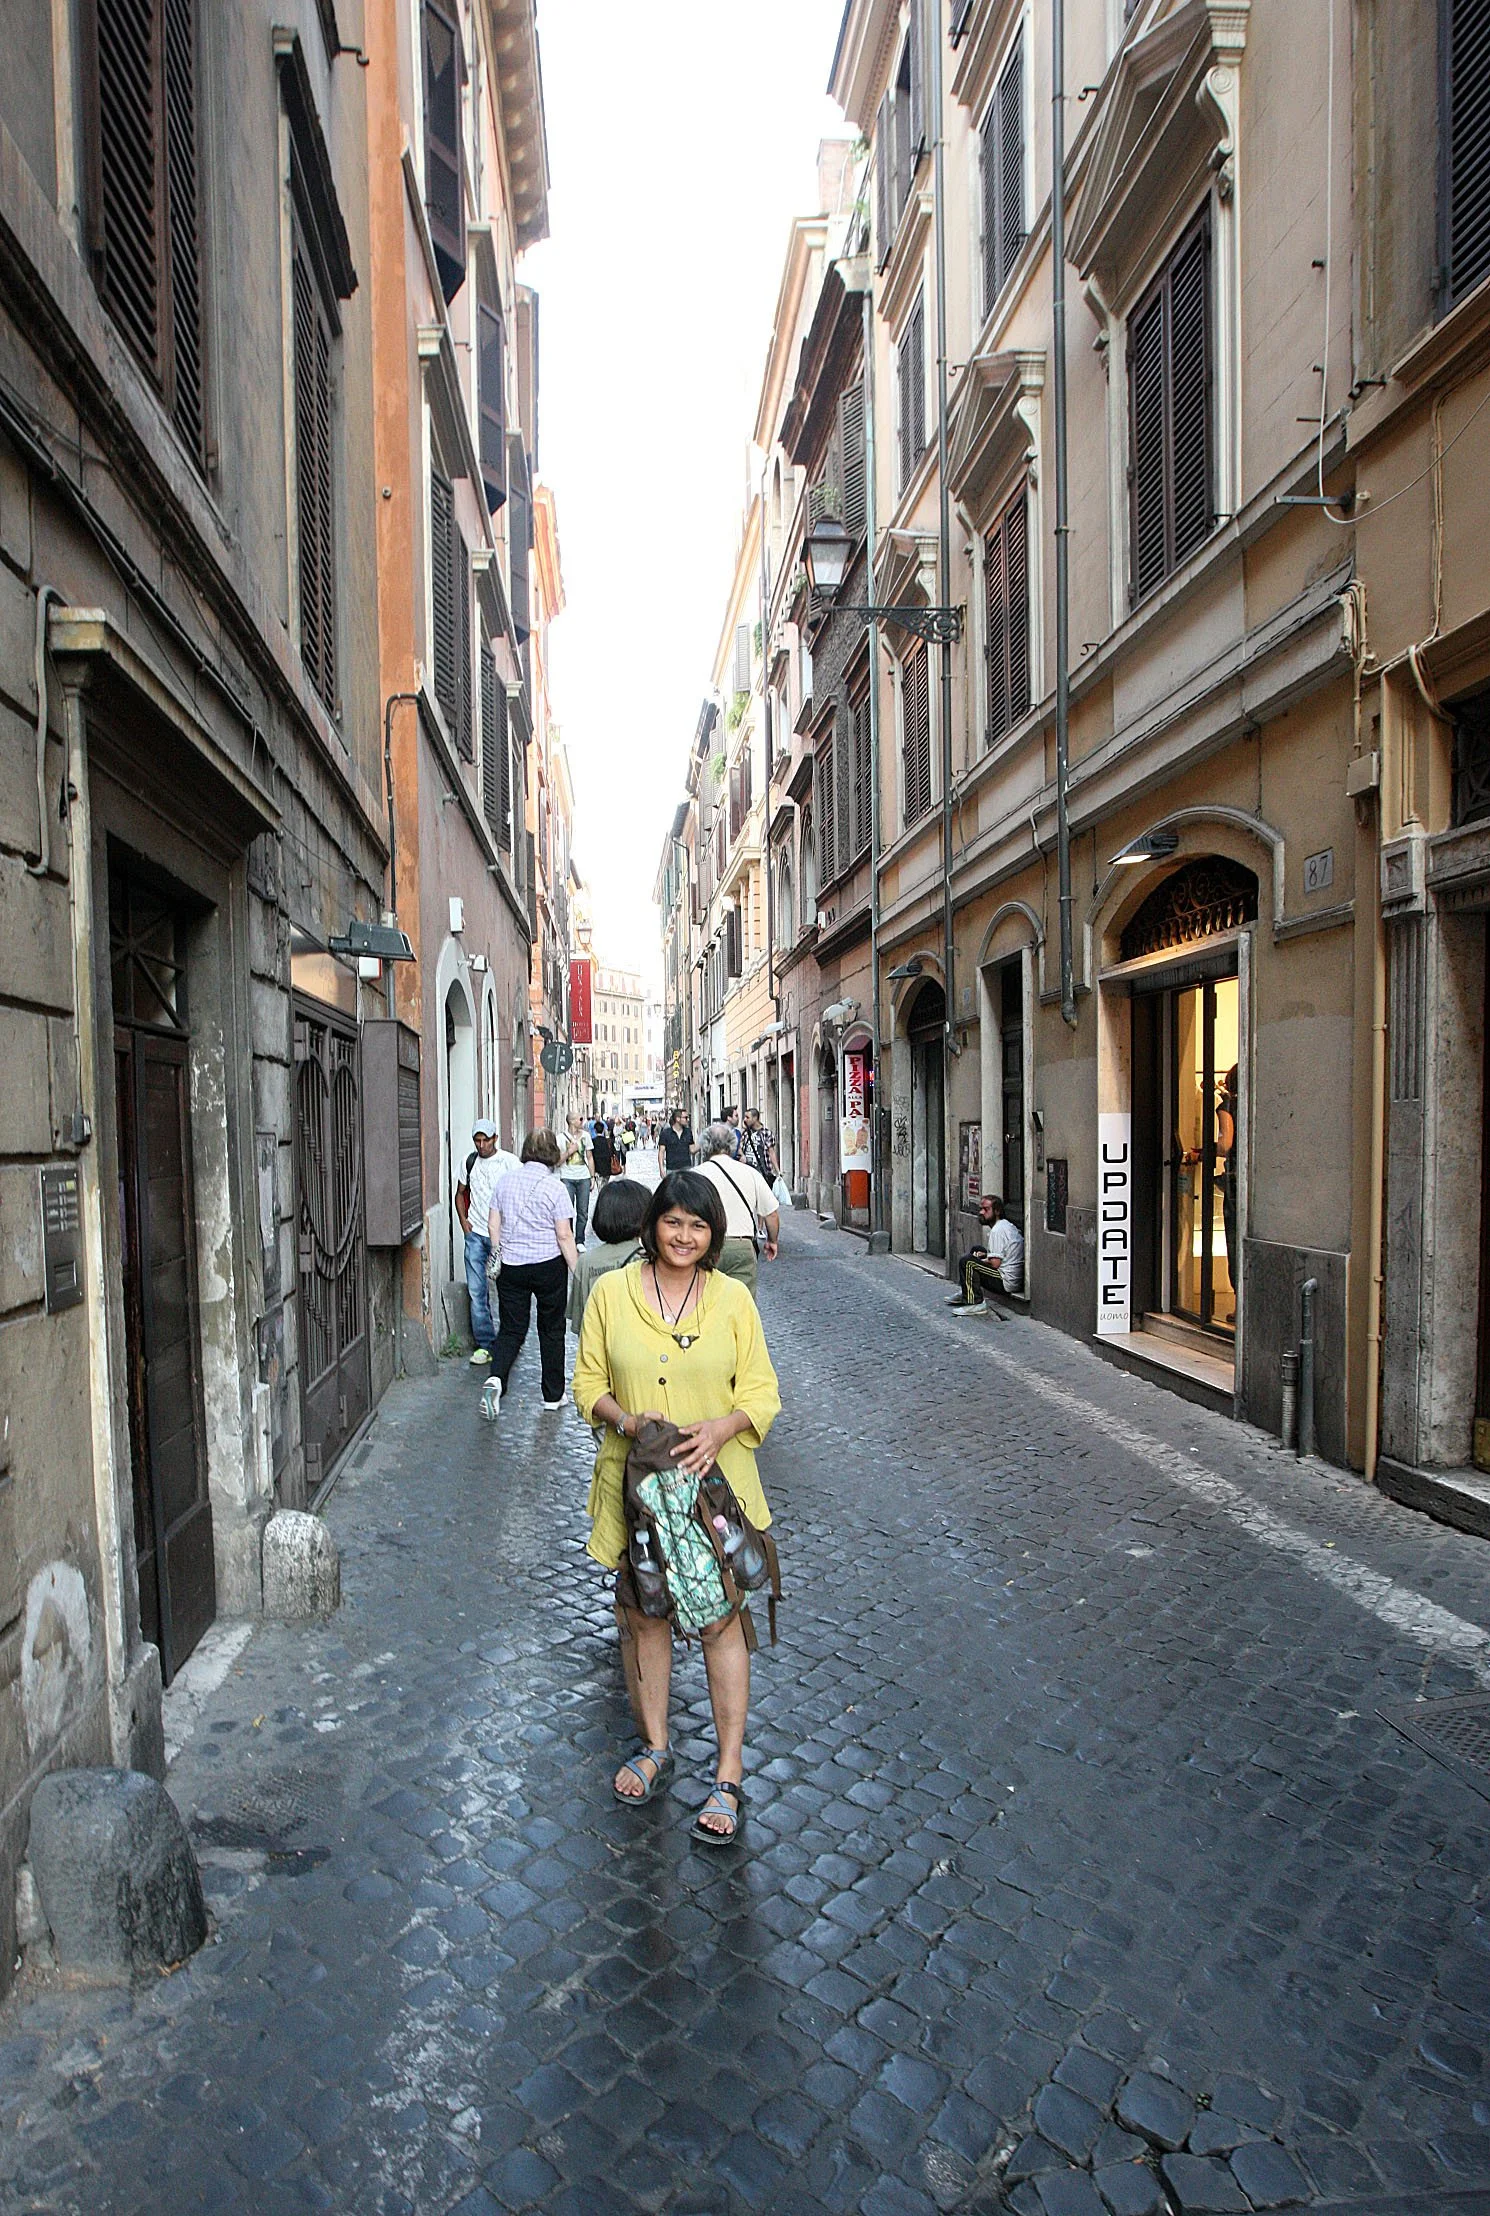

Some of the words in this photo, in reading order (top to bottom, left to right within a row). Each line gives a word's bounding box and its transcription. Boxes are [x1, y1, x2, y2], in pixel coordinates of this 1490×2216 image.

[1309, 855, 1329, 887] 87
[849, 1056, 863, 1094] PIZZA
[848, 1101, 863, 1118] PA
[1102, 1143, 1128, 1305] UPDATE
[1099, 1312, 1129, 1321] uomo
